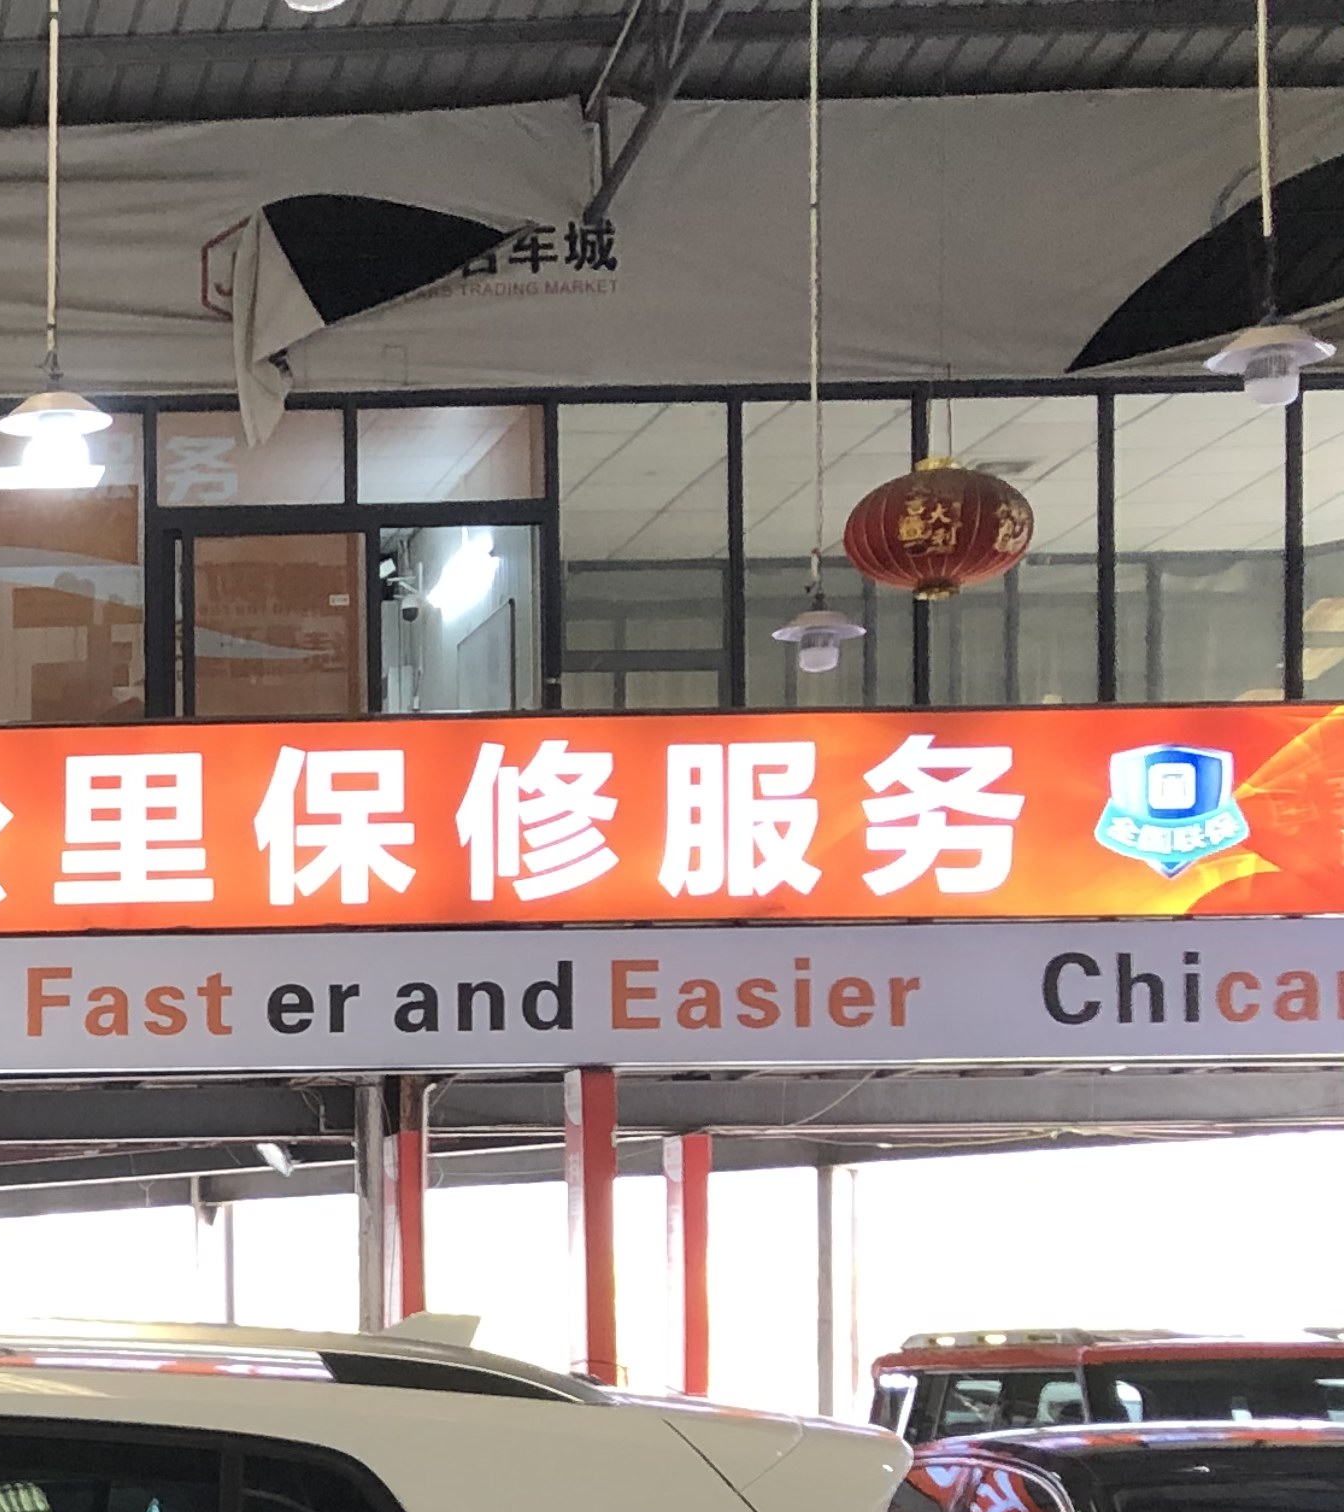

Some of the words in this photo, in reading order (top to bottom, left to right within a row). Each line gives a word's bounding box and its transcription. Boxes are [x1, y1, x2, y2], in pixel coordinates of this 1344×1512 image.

[461, 281, 540, 297] TRADING
[545, 279, 618, 295] MARKET
[394, 960, 574, 1033] and
[610, 957, 922, 1030] Easier
[1042, 951, 1344, 1025] Chica
